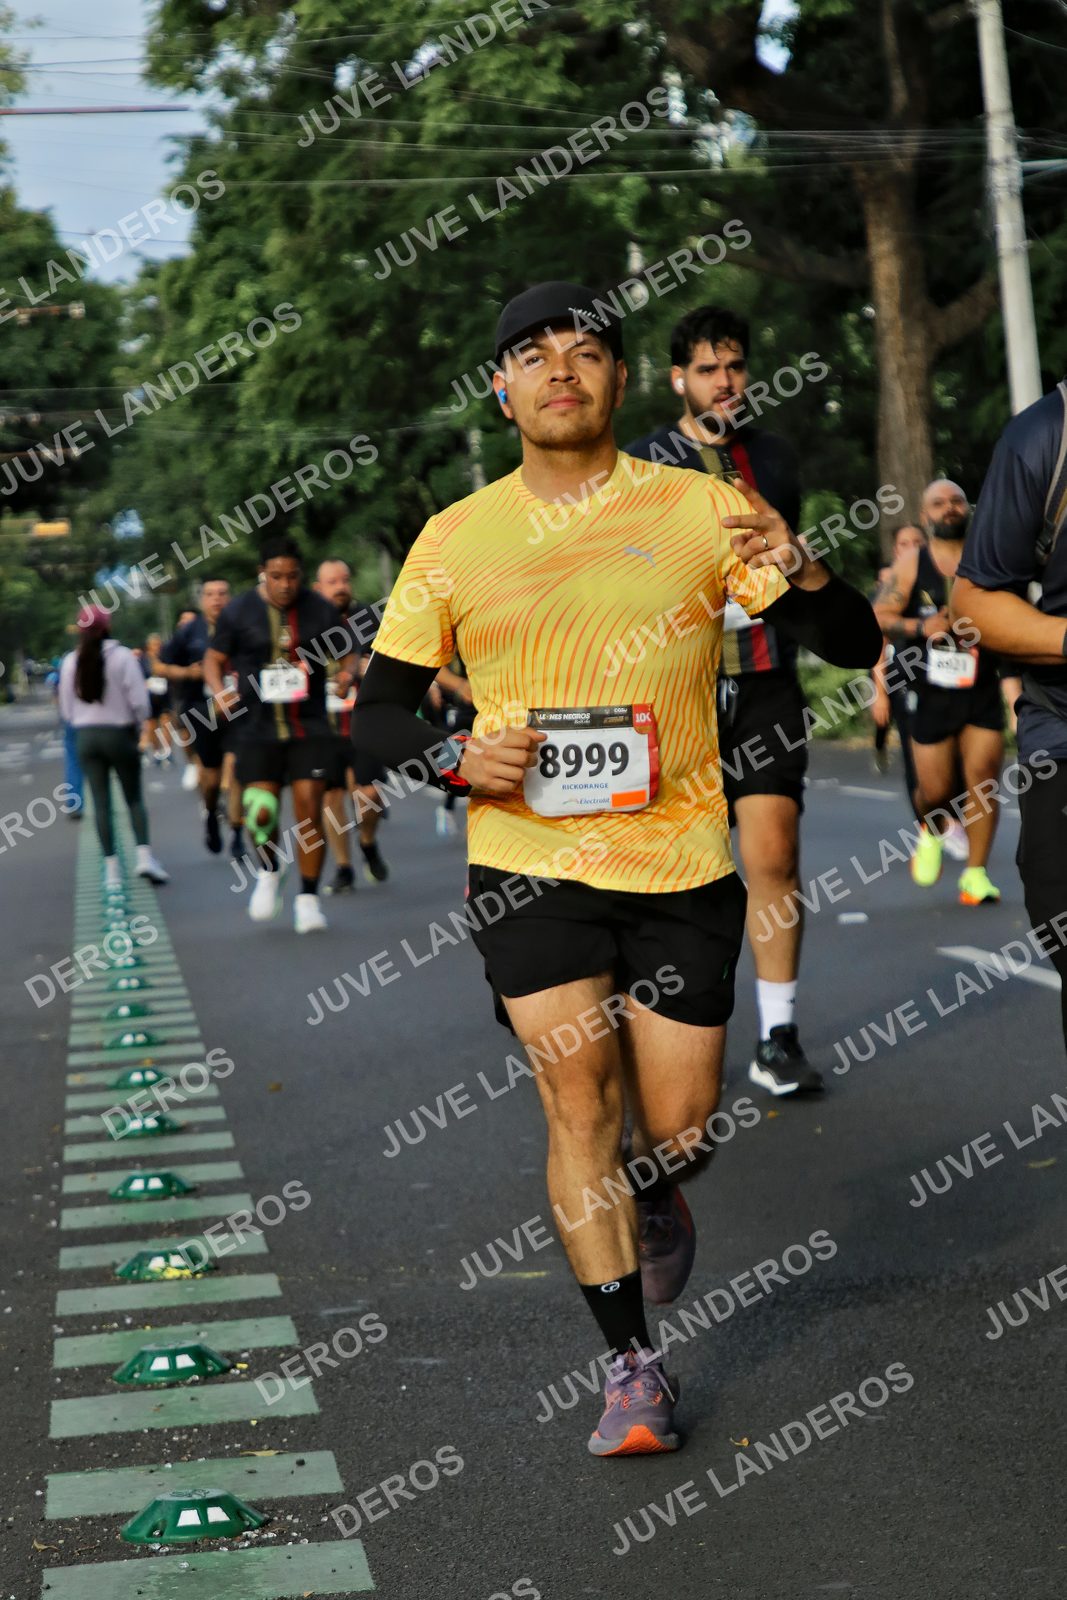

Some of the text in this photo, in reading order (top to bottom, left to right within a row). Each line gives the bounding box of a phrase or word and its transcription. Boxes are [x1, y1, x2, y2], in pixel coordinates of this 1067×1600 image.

[563, 712, 590, 720] NEGROS
[539, 741, 629, 778] 8999
[562, 782, 609, 790] RICKORANGE
